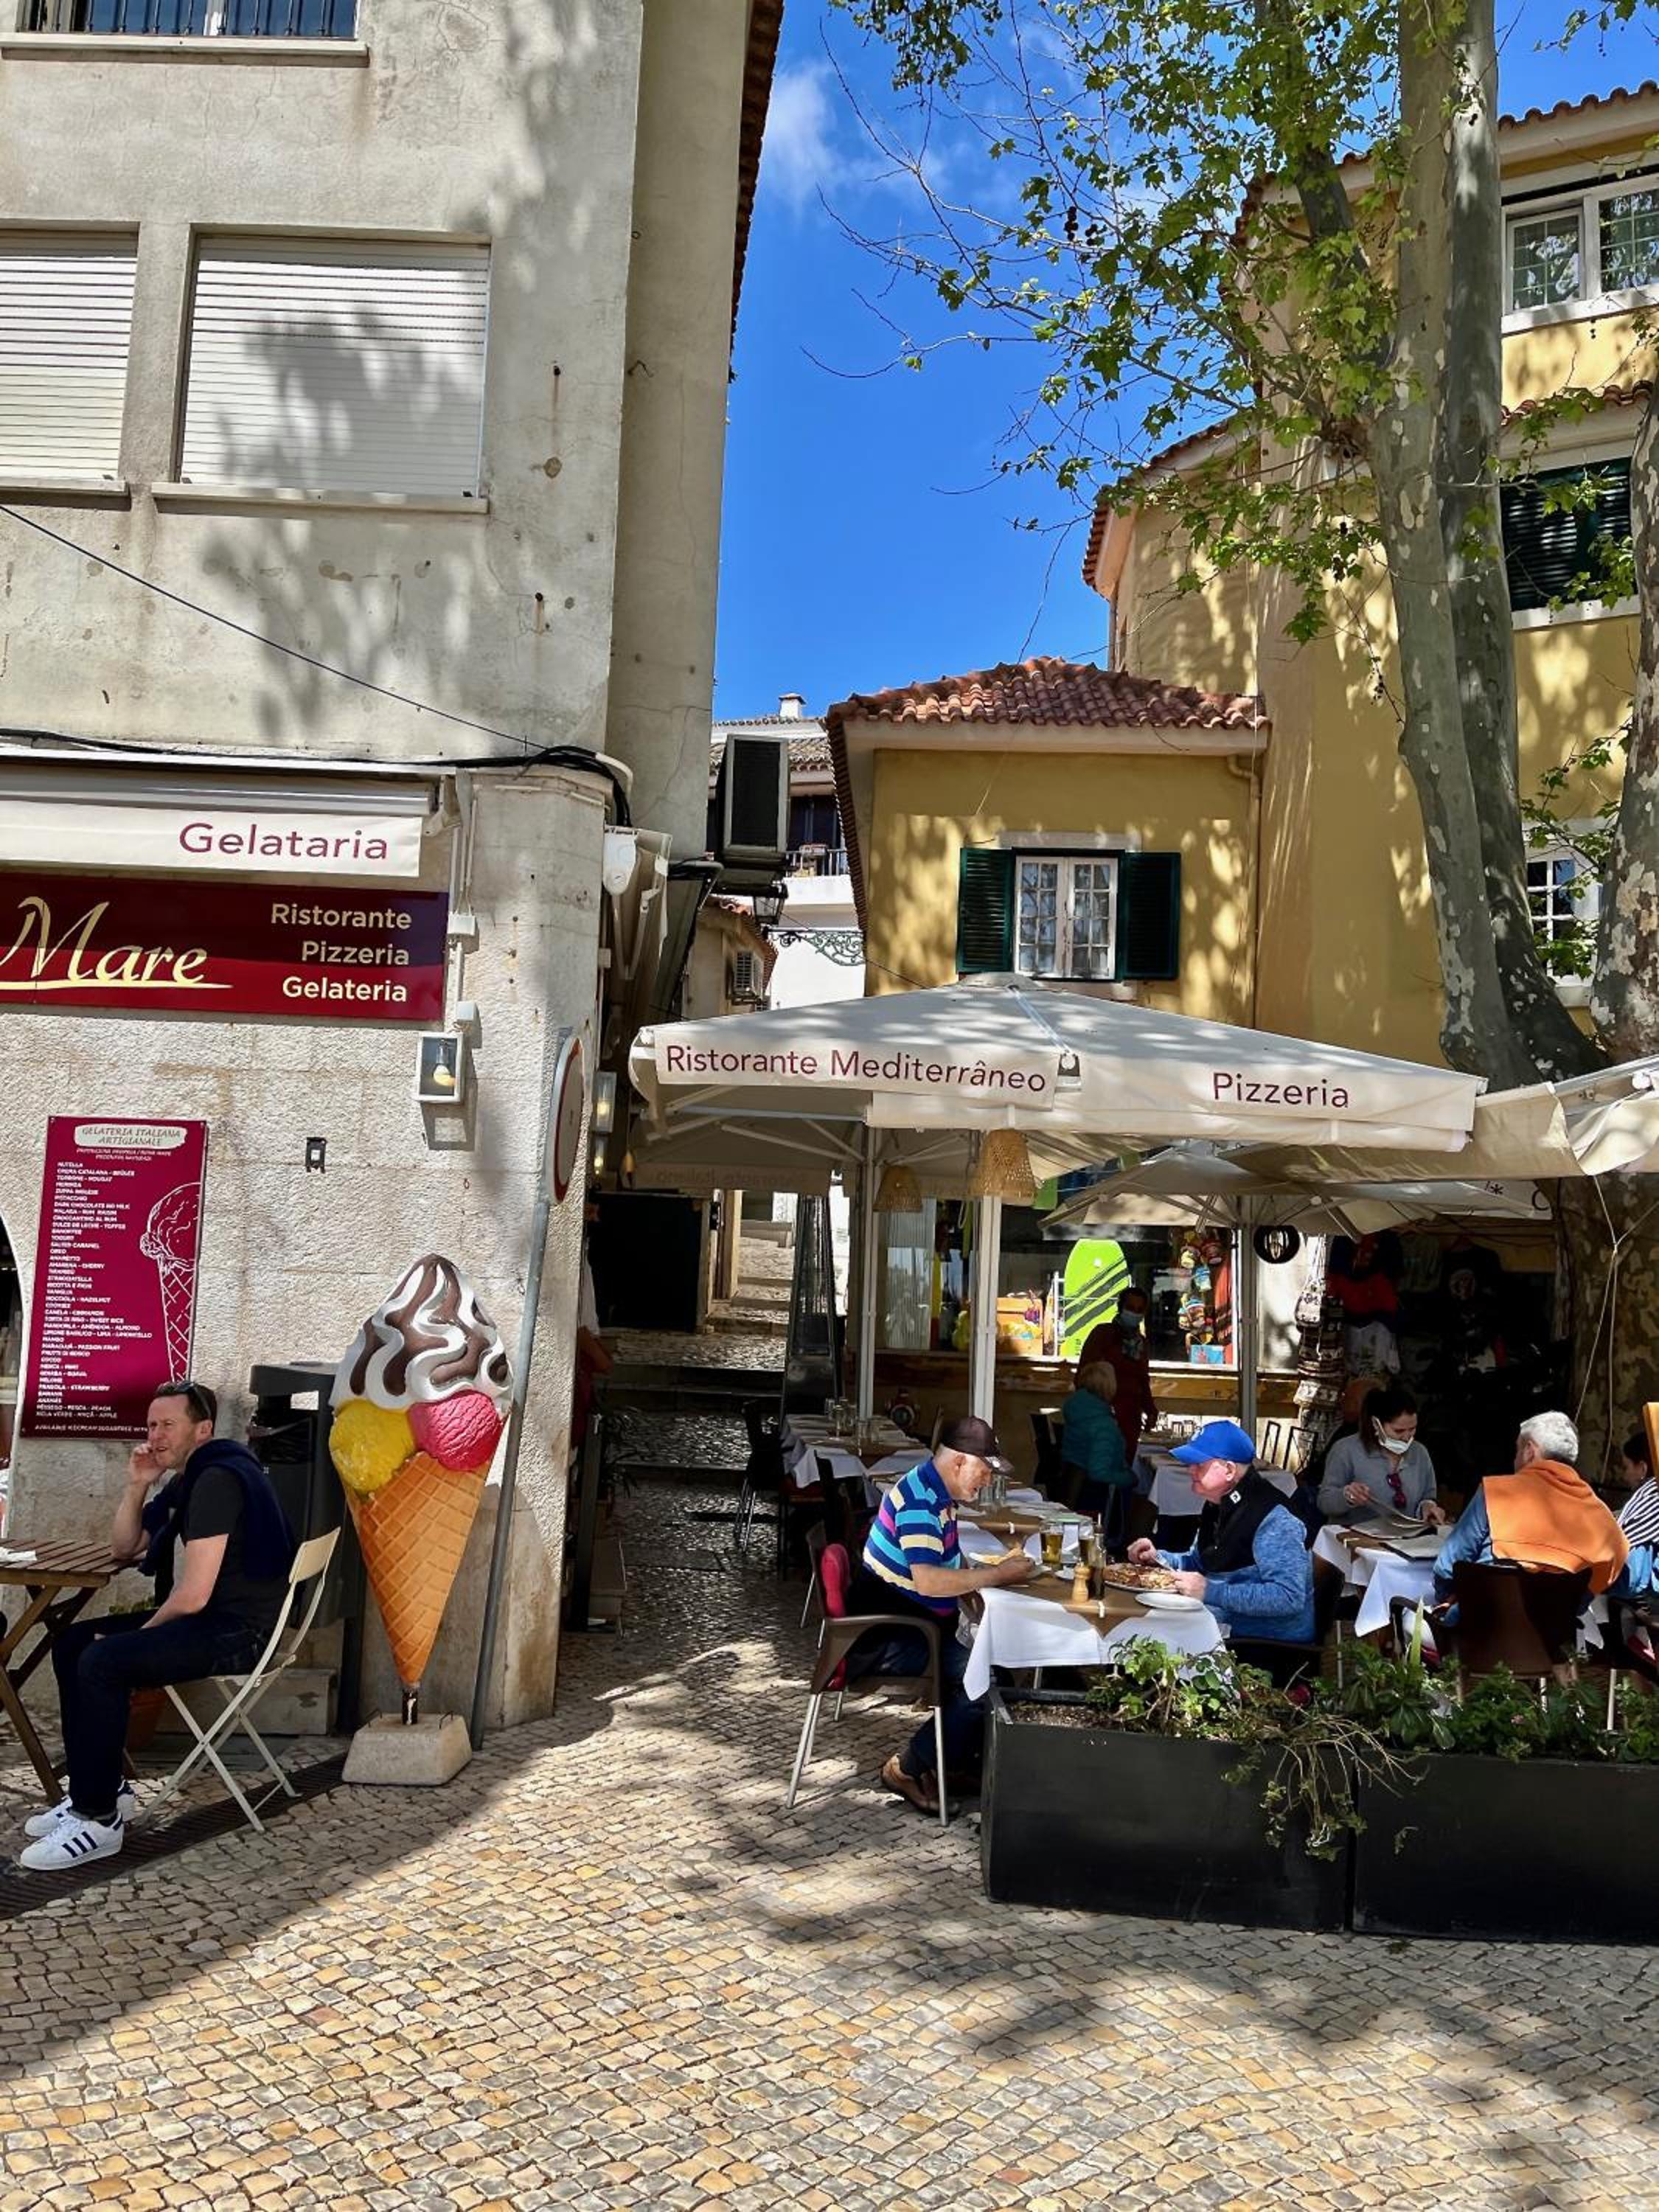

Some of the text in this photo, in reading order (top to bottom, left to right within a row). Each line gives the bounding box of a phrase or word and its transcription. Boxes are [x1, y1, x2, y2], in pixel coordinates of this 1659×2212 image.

[179, 821, 389, 860] Gelataria
[271, 902, 413, 930] Ristorante
[0, 895, 208, 984] Mare
[302, 940, 410, 967] Pizzeria
[282, 976, 408, 1003] Gelateria
[666, 1044, 1046, 1092] Ristorante Mediterrâneo
[1213, 1072, 1349, 1108] Pizzeria
